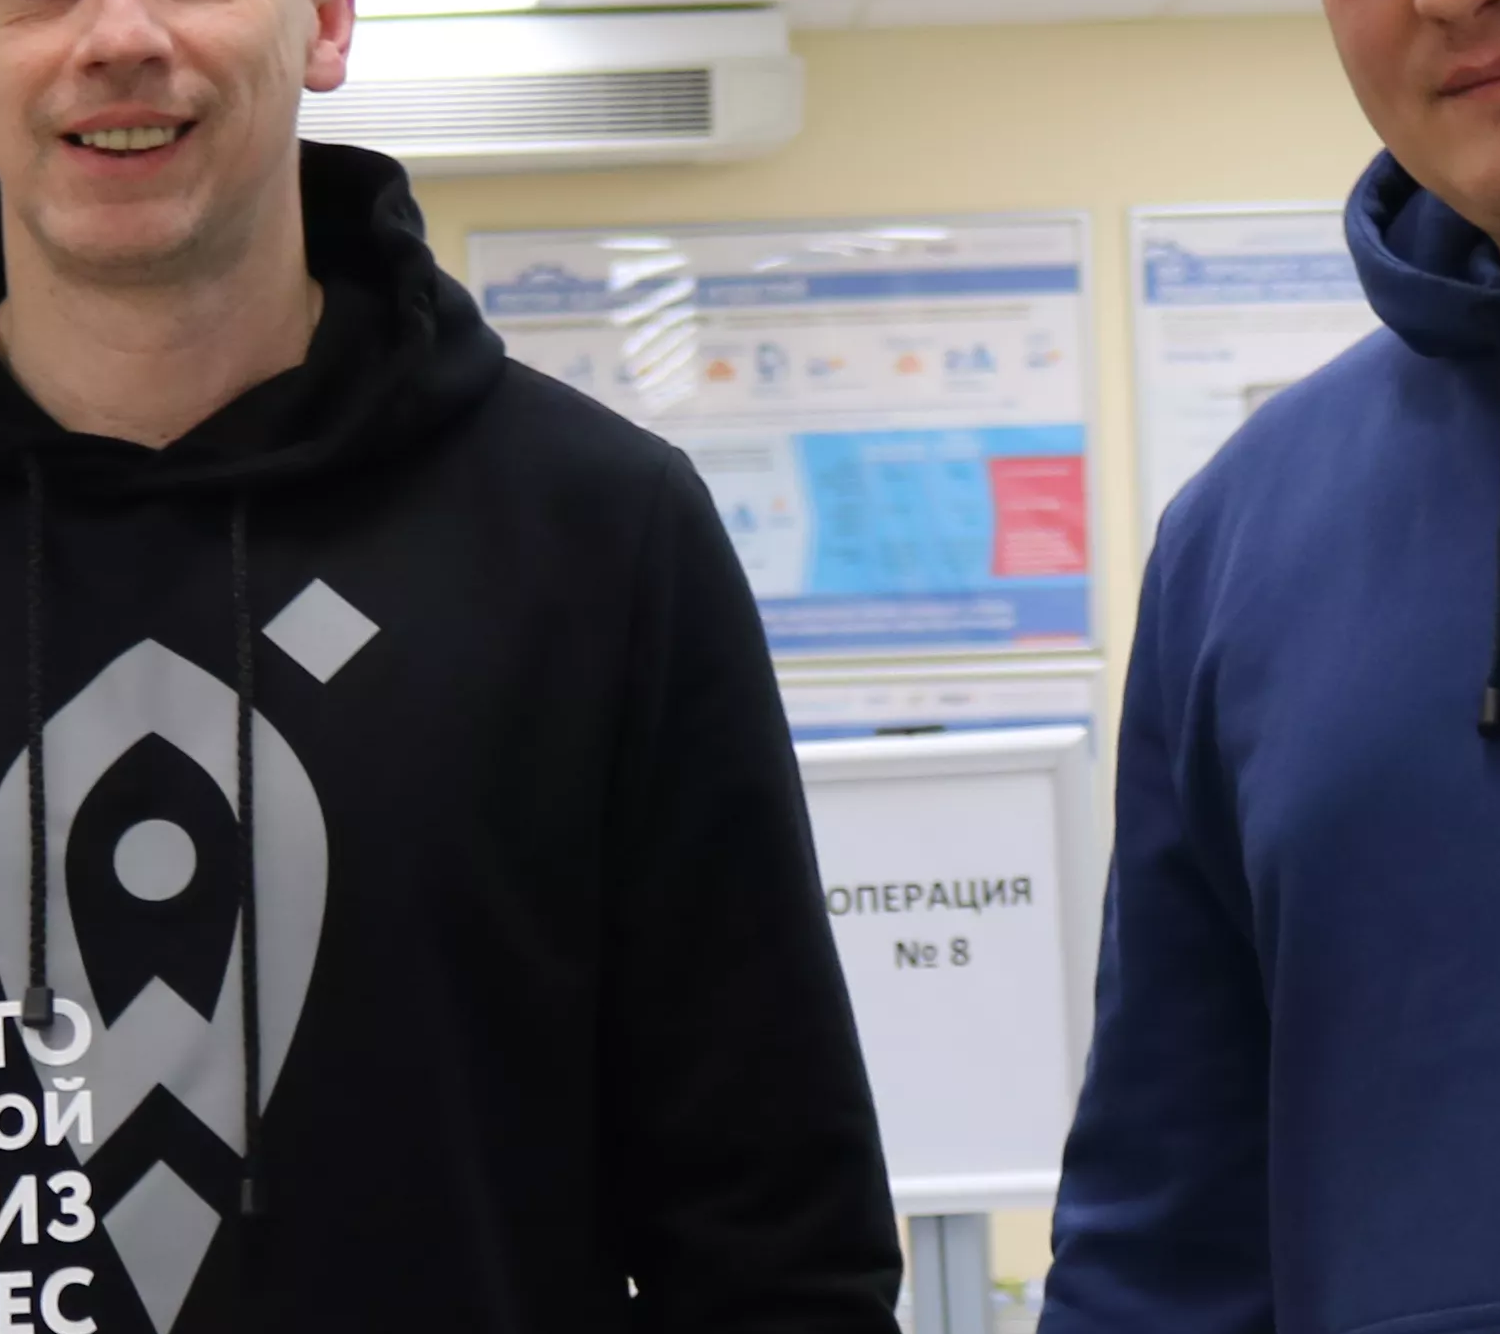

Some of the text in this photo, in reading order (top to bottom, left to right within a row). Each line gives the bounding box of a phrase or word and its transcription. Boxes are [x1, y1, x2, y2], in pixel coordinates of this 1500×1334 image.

[826, 876, 1033, 916] ОПЕРАЦИЯ
[894, 938, 972, 969] № 8
